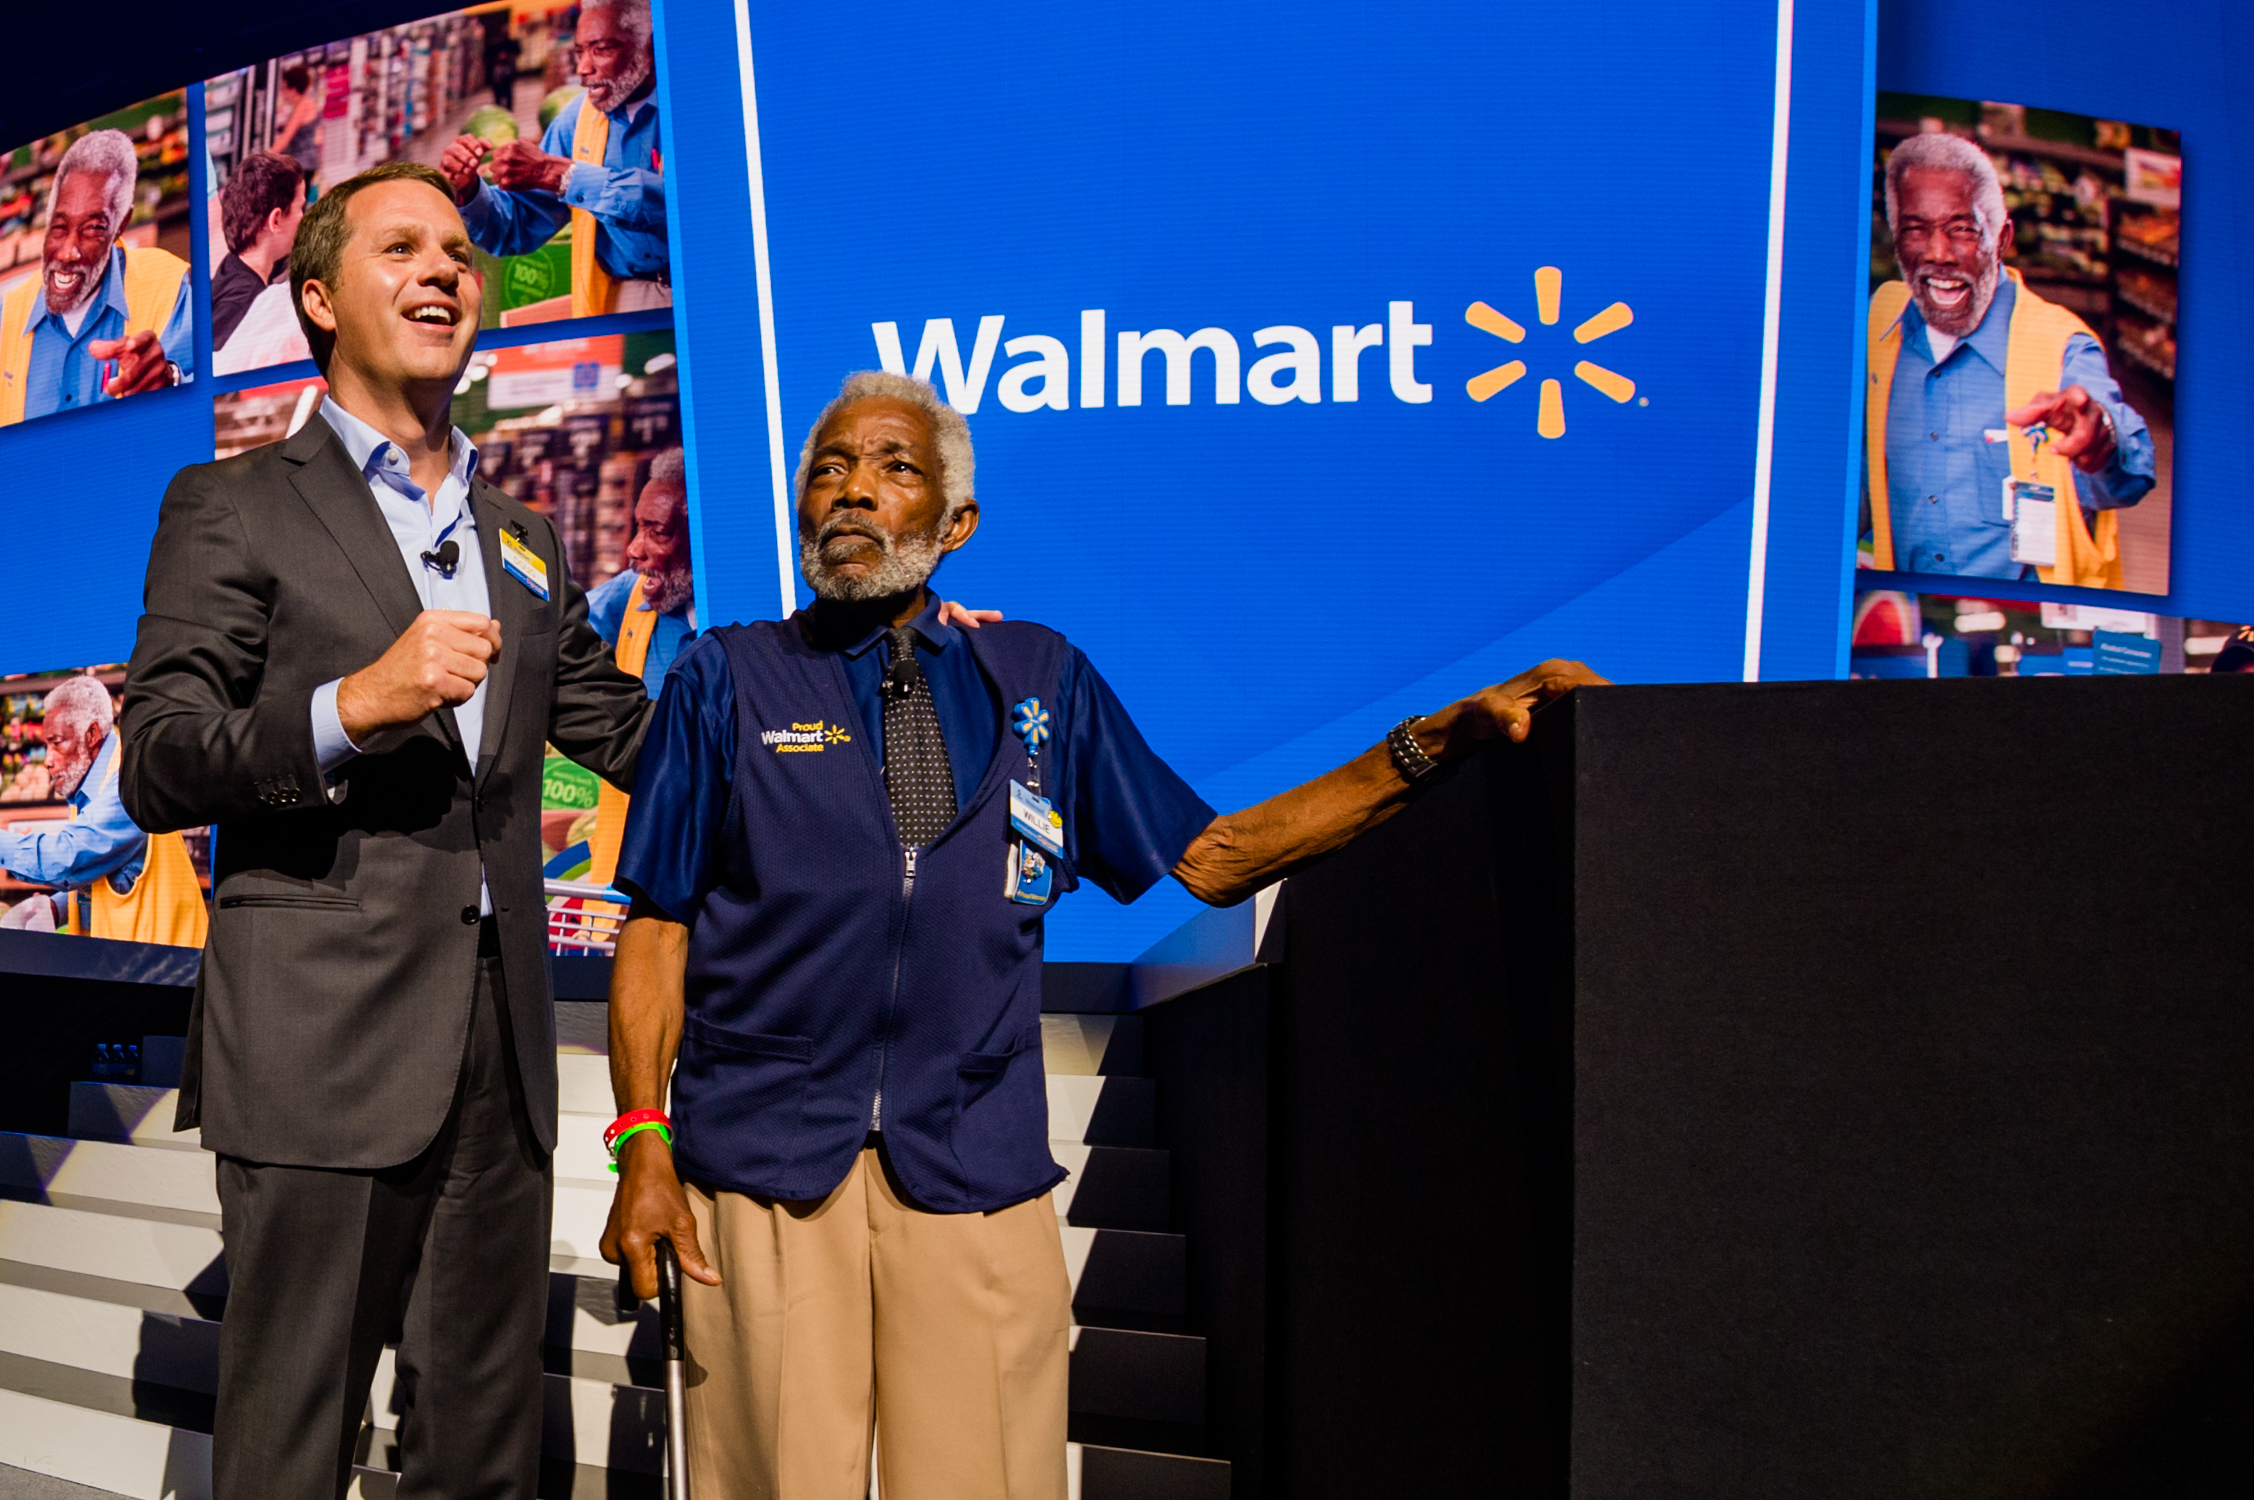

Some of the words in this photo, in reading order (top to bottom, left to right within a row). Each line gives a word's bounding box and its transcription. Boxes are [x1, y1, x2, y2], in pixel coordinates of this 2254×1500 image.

[871, 300, 1433, 416] Walmart
[792, 720, 824, 731] Proud
[761, 730, 824, 745] Walmart
[776, 743, 825, 753] Associate
[543, 779, 594, 808] 100%
[1023, 808, 1051, 835] WILLIE
